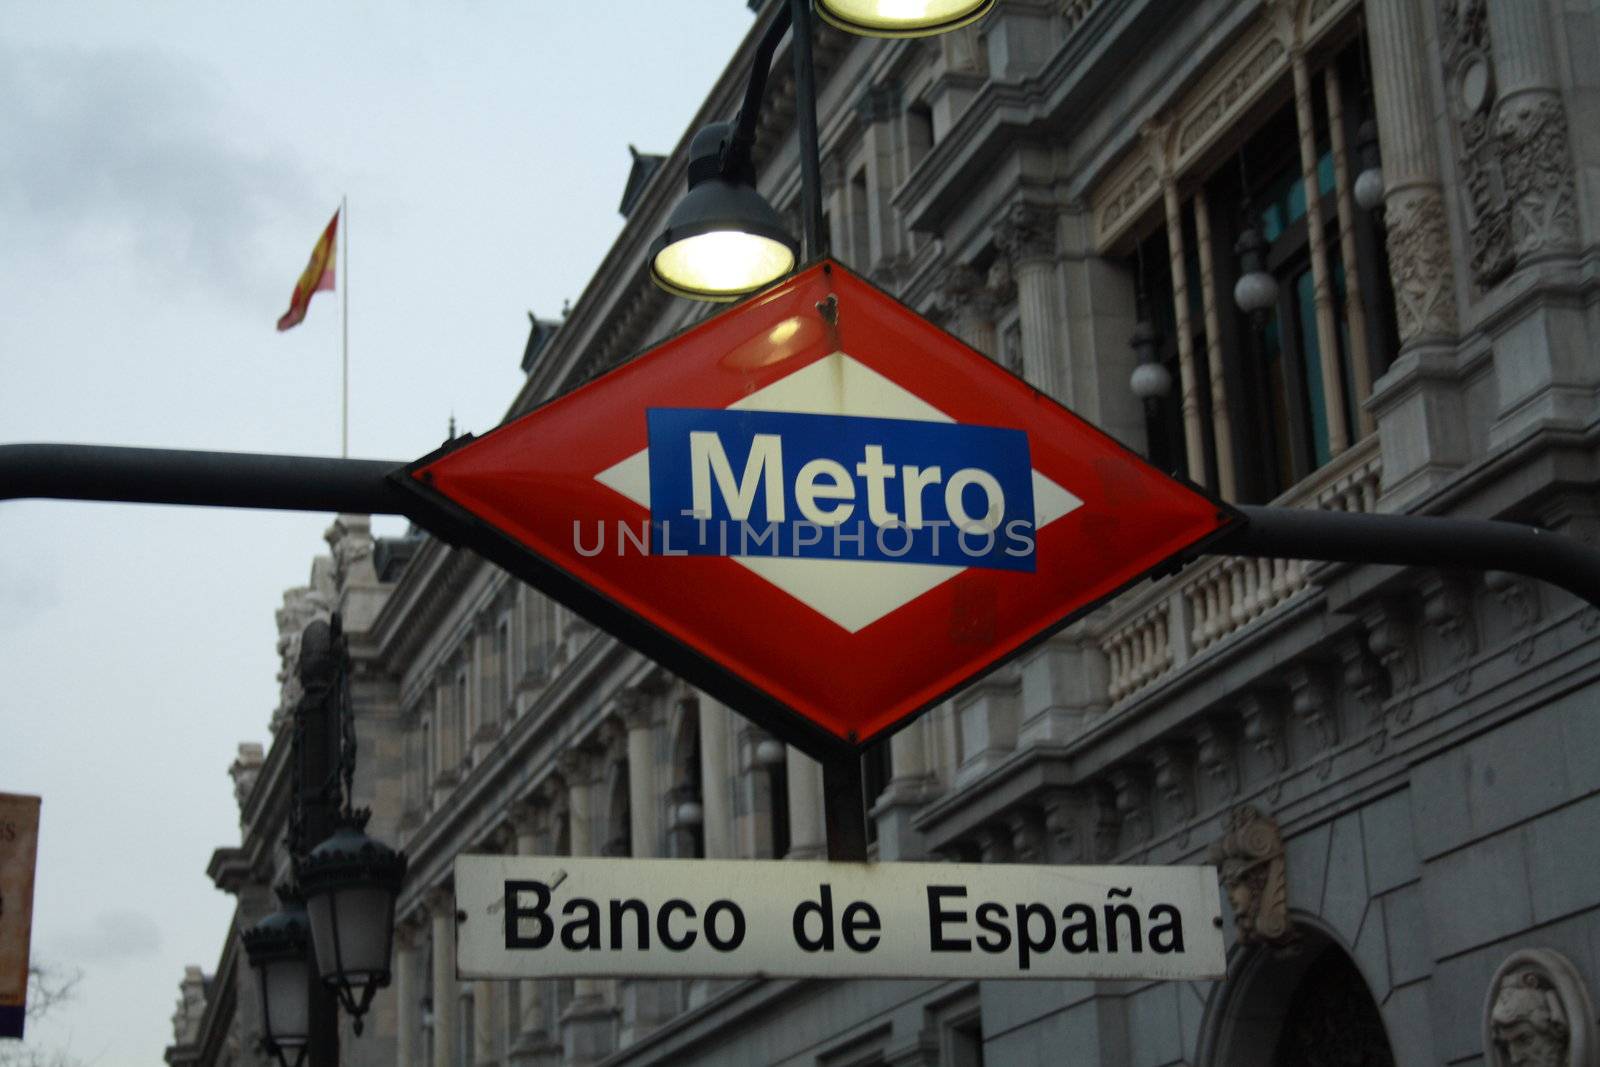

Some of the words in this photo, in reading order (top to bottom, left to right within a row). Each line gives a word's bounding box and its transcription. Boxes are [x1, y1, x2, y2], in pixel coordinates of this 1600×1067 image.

[689, 430, 1005, 536] Metro
[504, 879, 746, 952] Banco
[793, 884, 881, 953] de
[927, 885, 1185, 970] España
